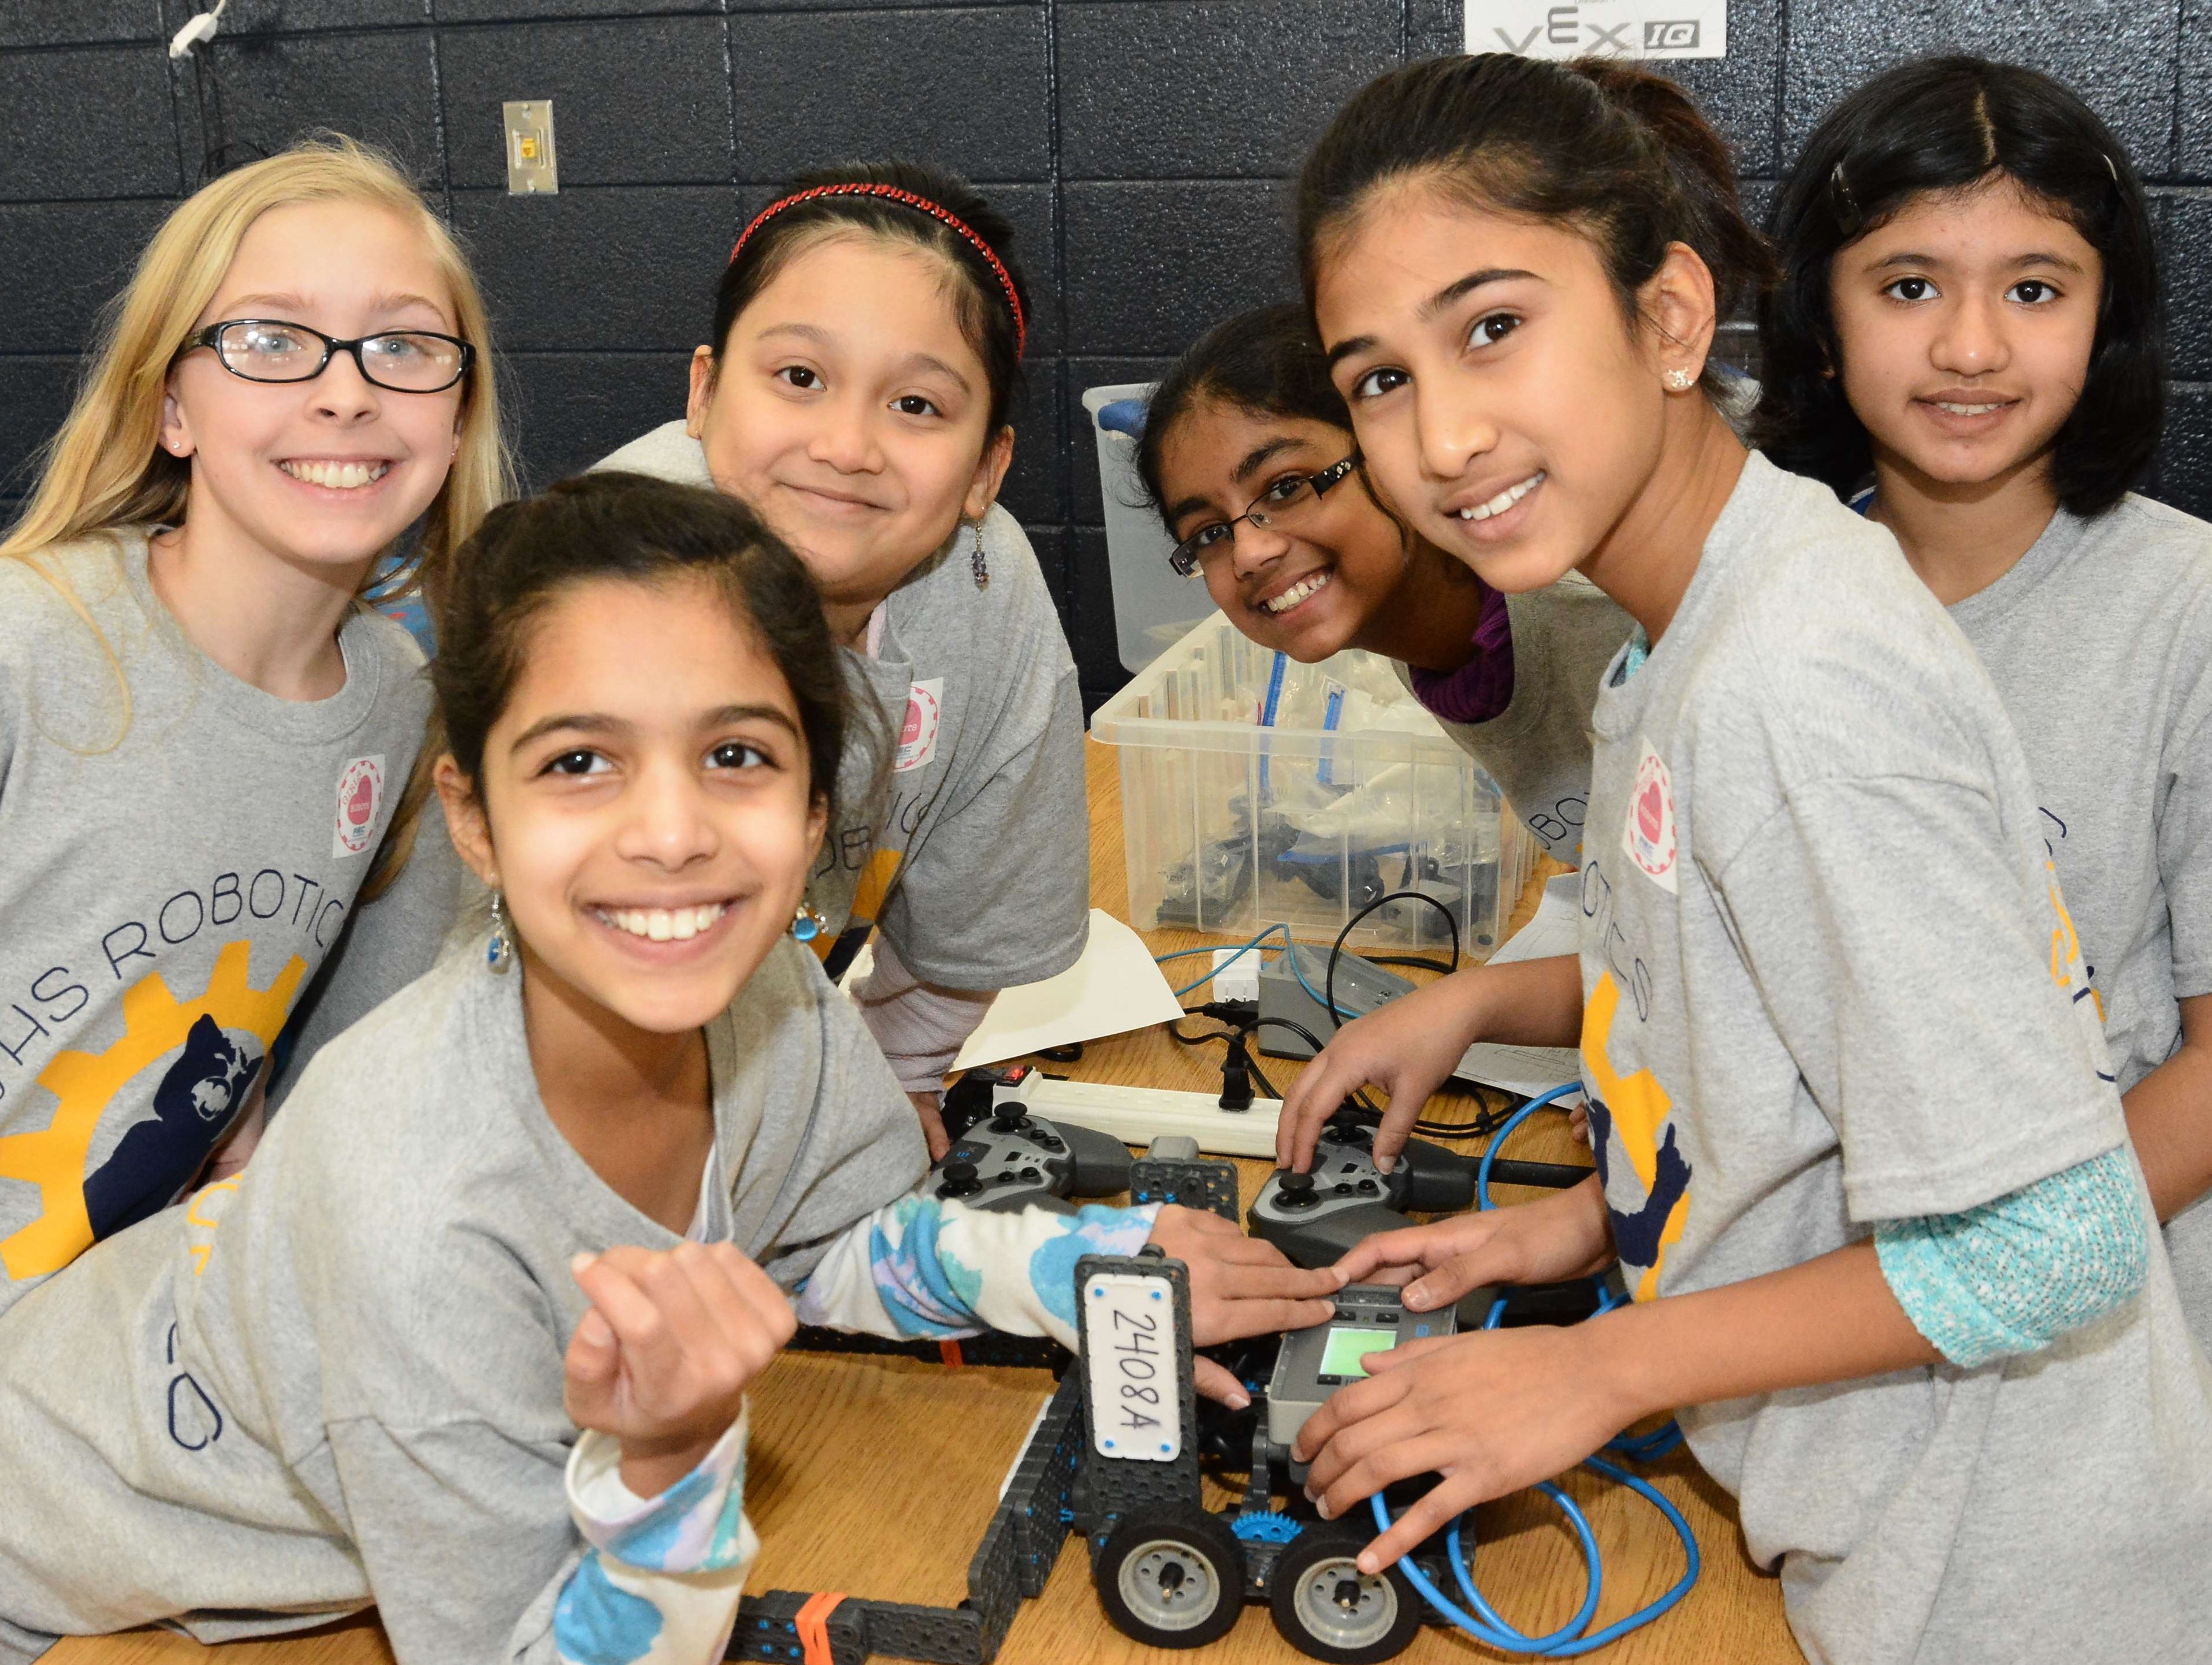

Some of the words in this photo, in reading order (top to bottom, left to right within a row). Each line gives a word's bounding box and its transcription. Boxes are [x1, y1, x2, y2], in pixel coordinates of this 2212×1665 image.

[1493, 6, 1630, 54] VEX
[1646, 21, 1697, 47] IQ
[0, 966, 89, 1100] HS
[102, 869, 348, 979] ROBOTIC
[1113, 1309, 1161, 1429] 2408A
